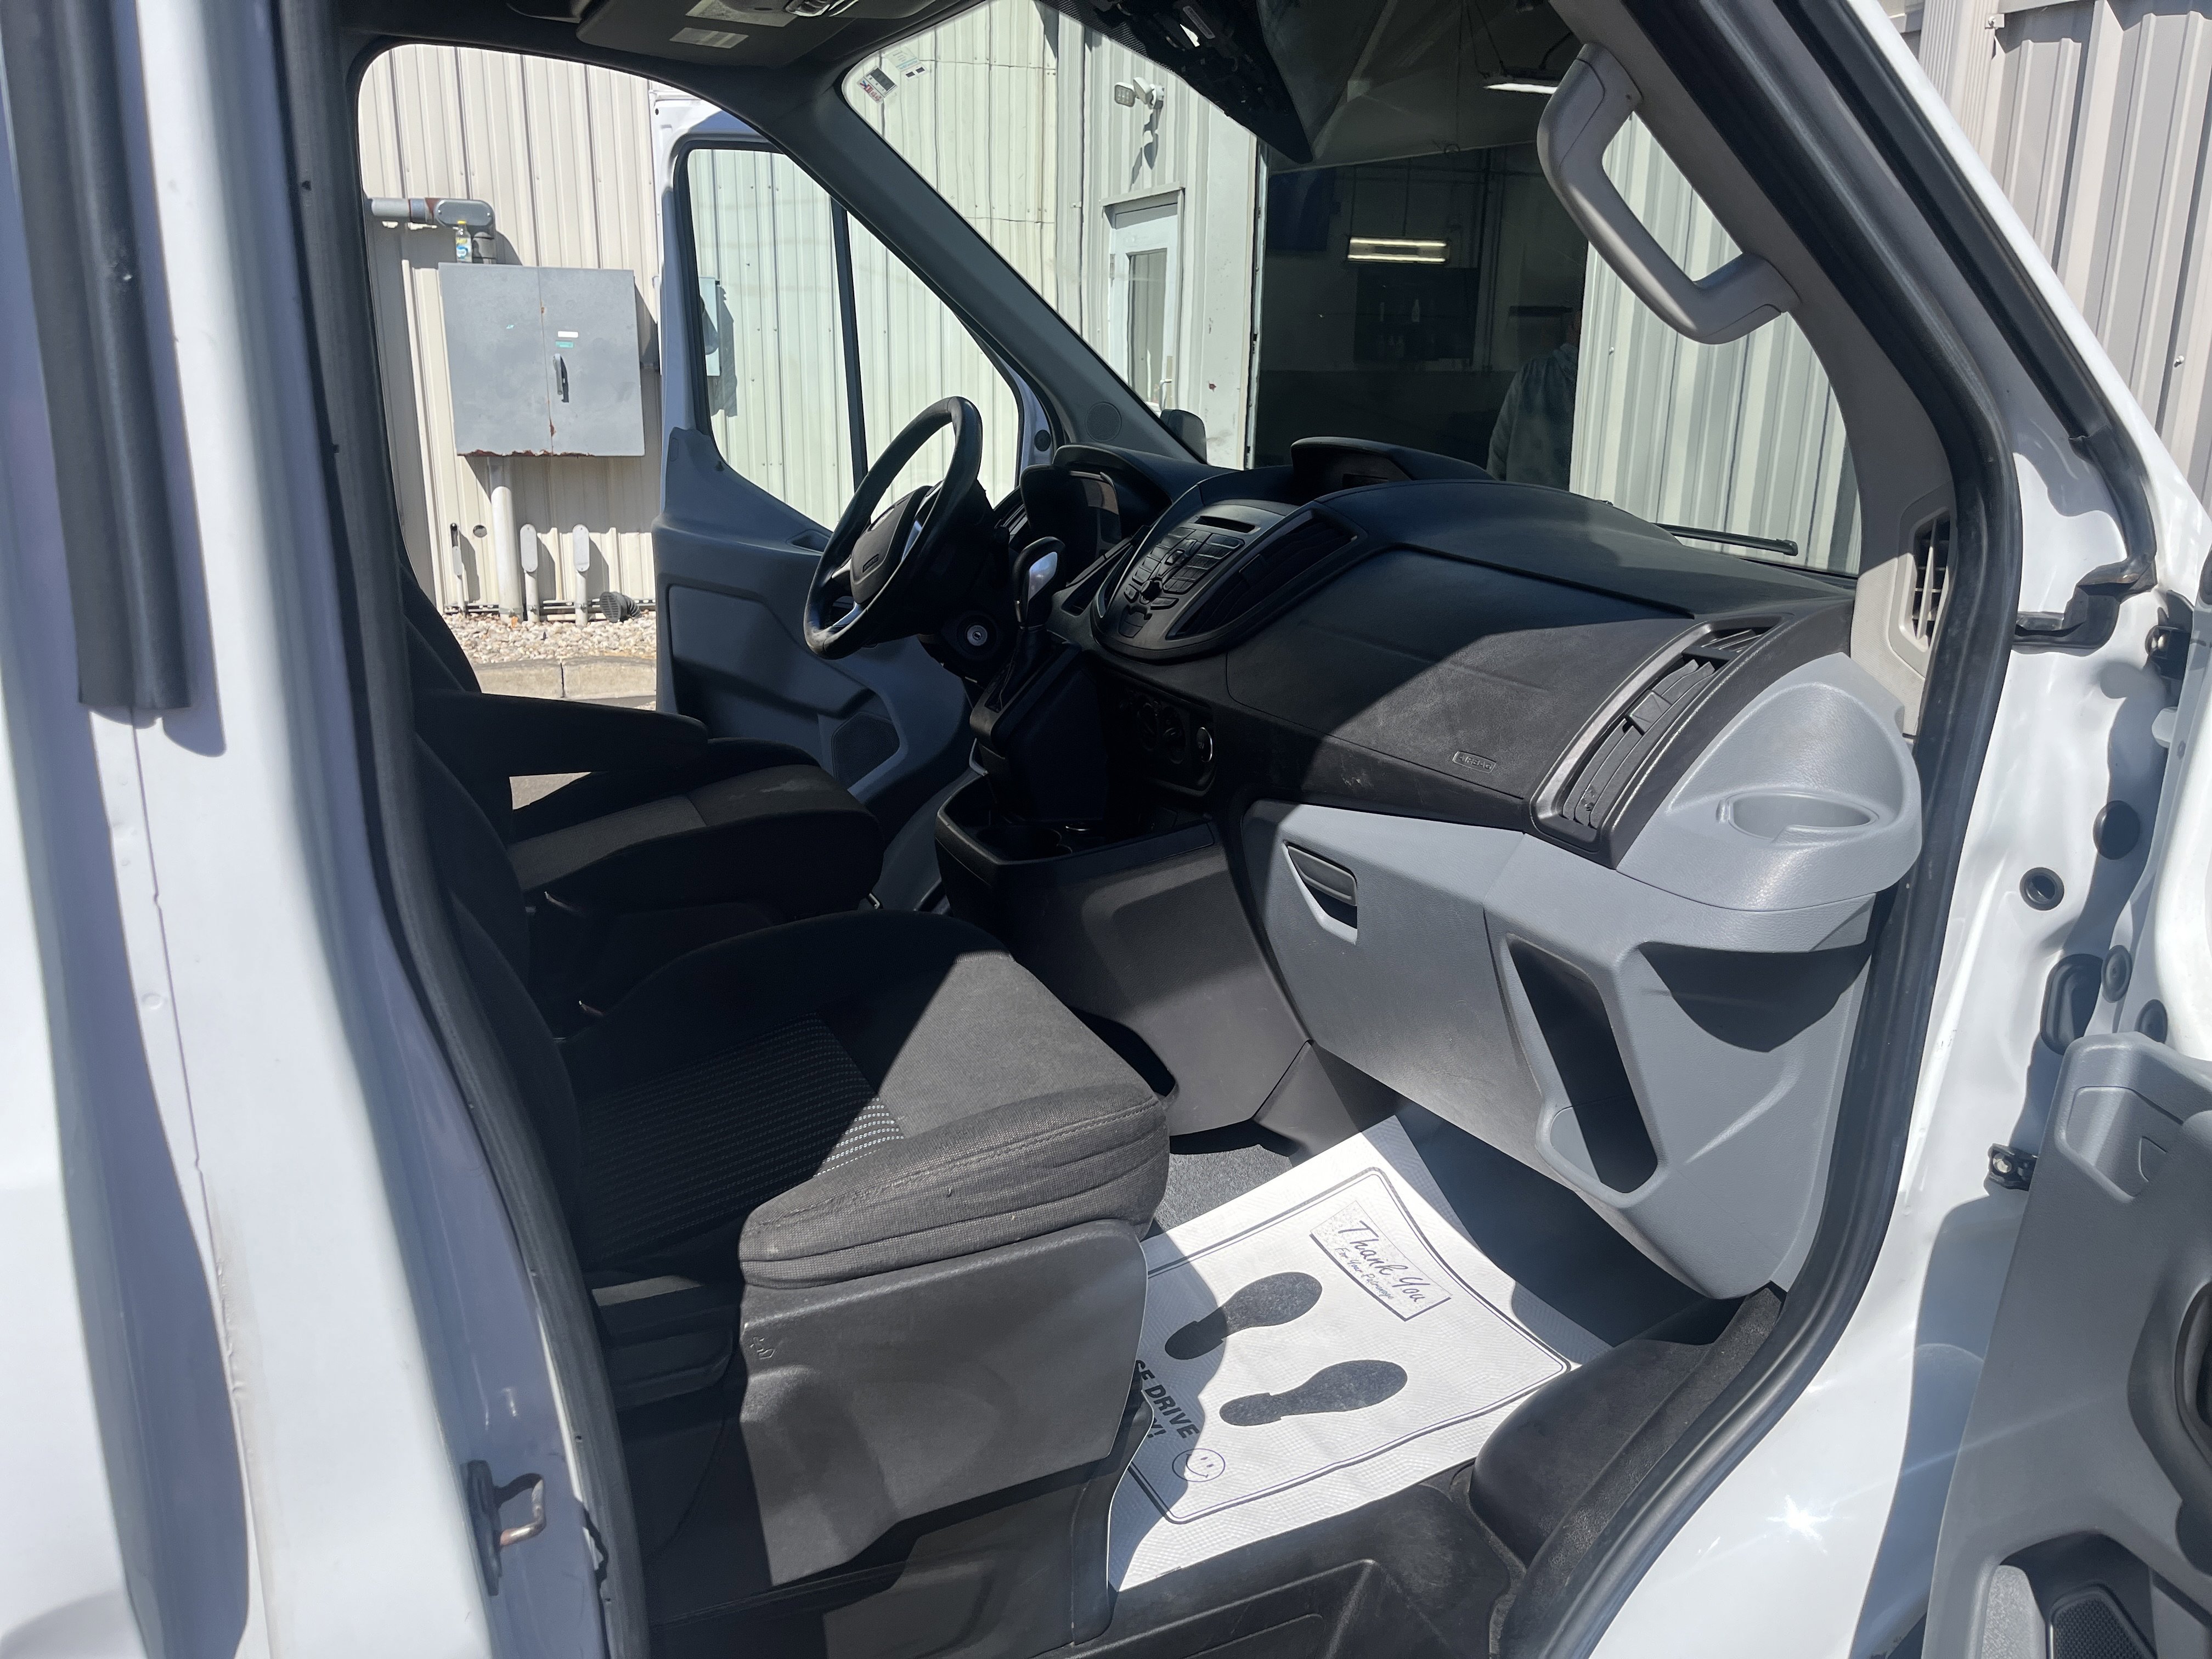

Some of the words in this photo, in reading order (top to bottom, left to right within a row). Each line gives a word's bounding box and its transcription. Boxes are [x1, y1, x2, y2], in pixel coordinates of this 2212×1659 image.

[1458, 754, 1493, 770] AIRBAG
[1334, 1247, 1350, 1259] For
[1347, 1260, 1364, 1273] Your
[1361, 1273, 1395, 1300] Patronage
[1338, 1220, 1409, 1275] Thank
[1392, 1277, 1431, 1302] You
[1145, 1384, 1200, 1438] DRIVE
